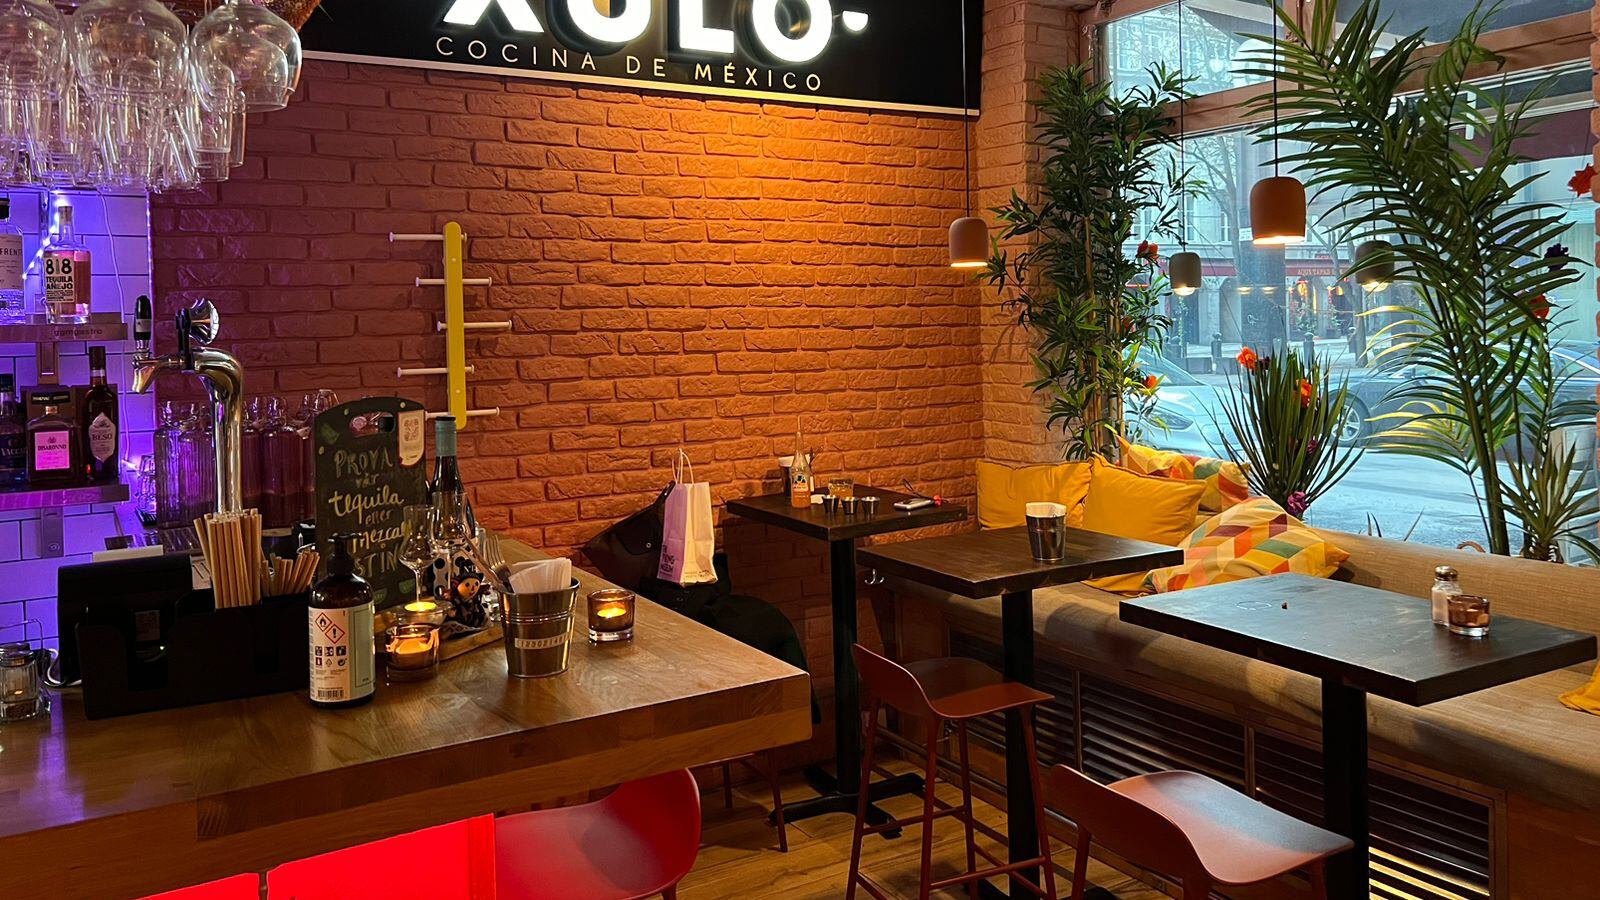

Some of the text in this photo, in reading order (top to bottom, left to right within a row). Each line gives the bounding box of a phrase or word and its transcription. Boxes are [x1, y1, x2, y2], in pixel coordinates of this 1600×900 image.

[436, 36, 821, 91] COCINA DE MÉXICO
[46, 258, 72, 275] 818
[334, 447, 393, 478] PROVA
[328, 484, 404, 525] tequila
